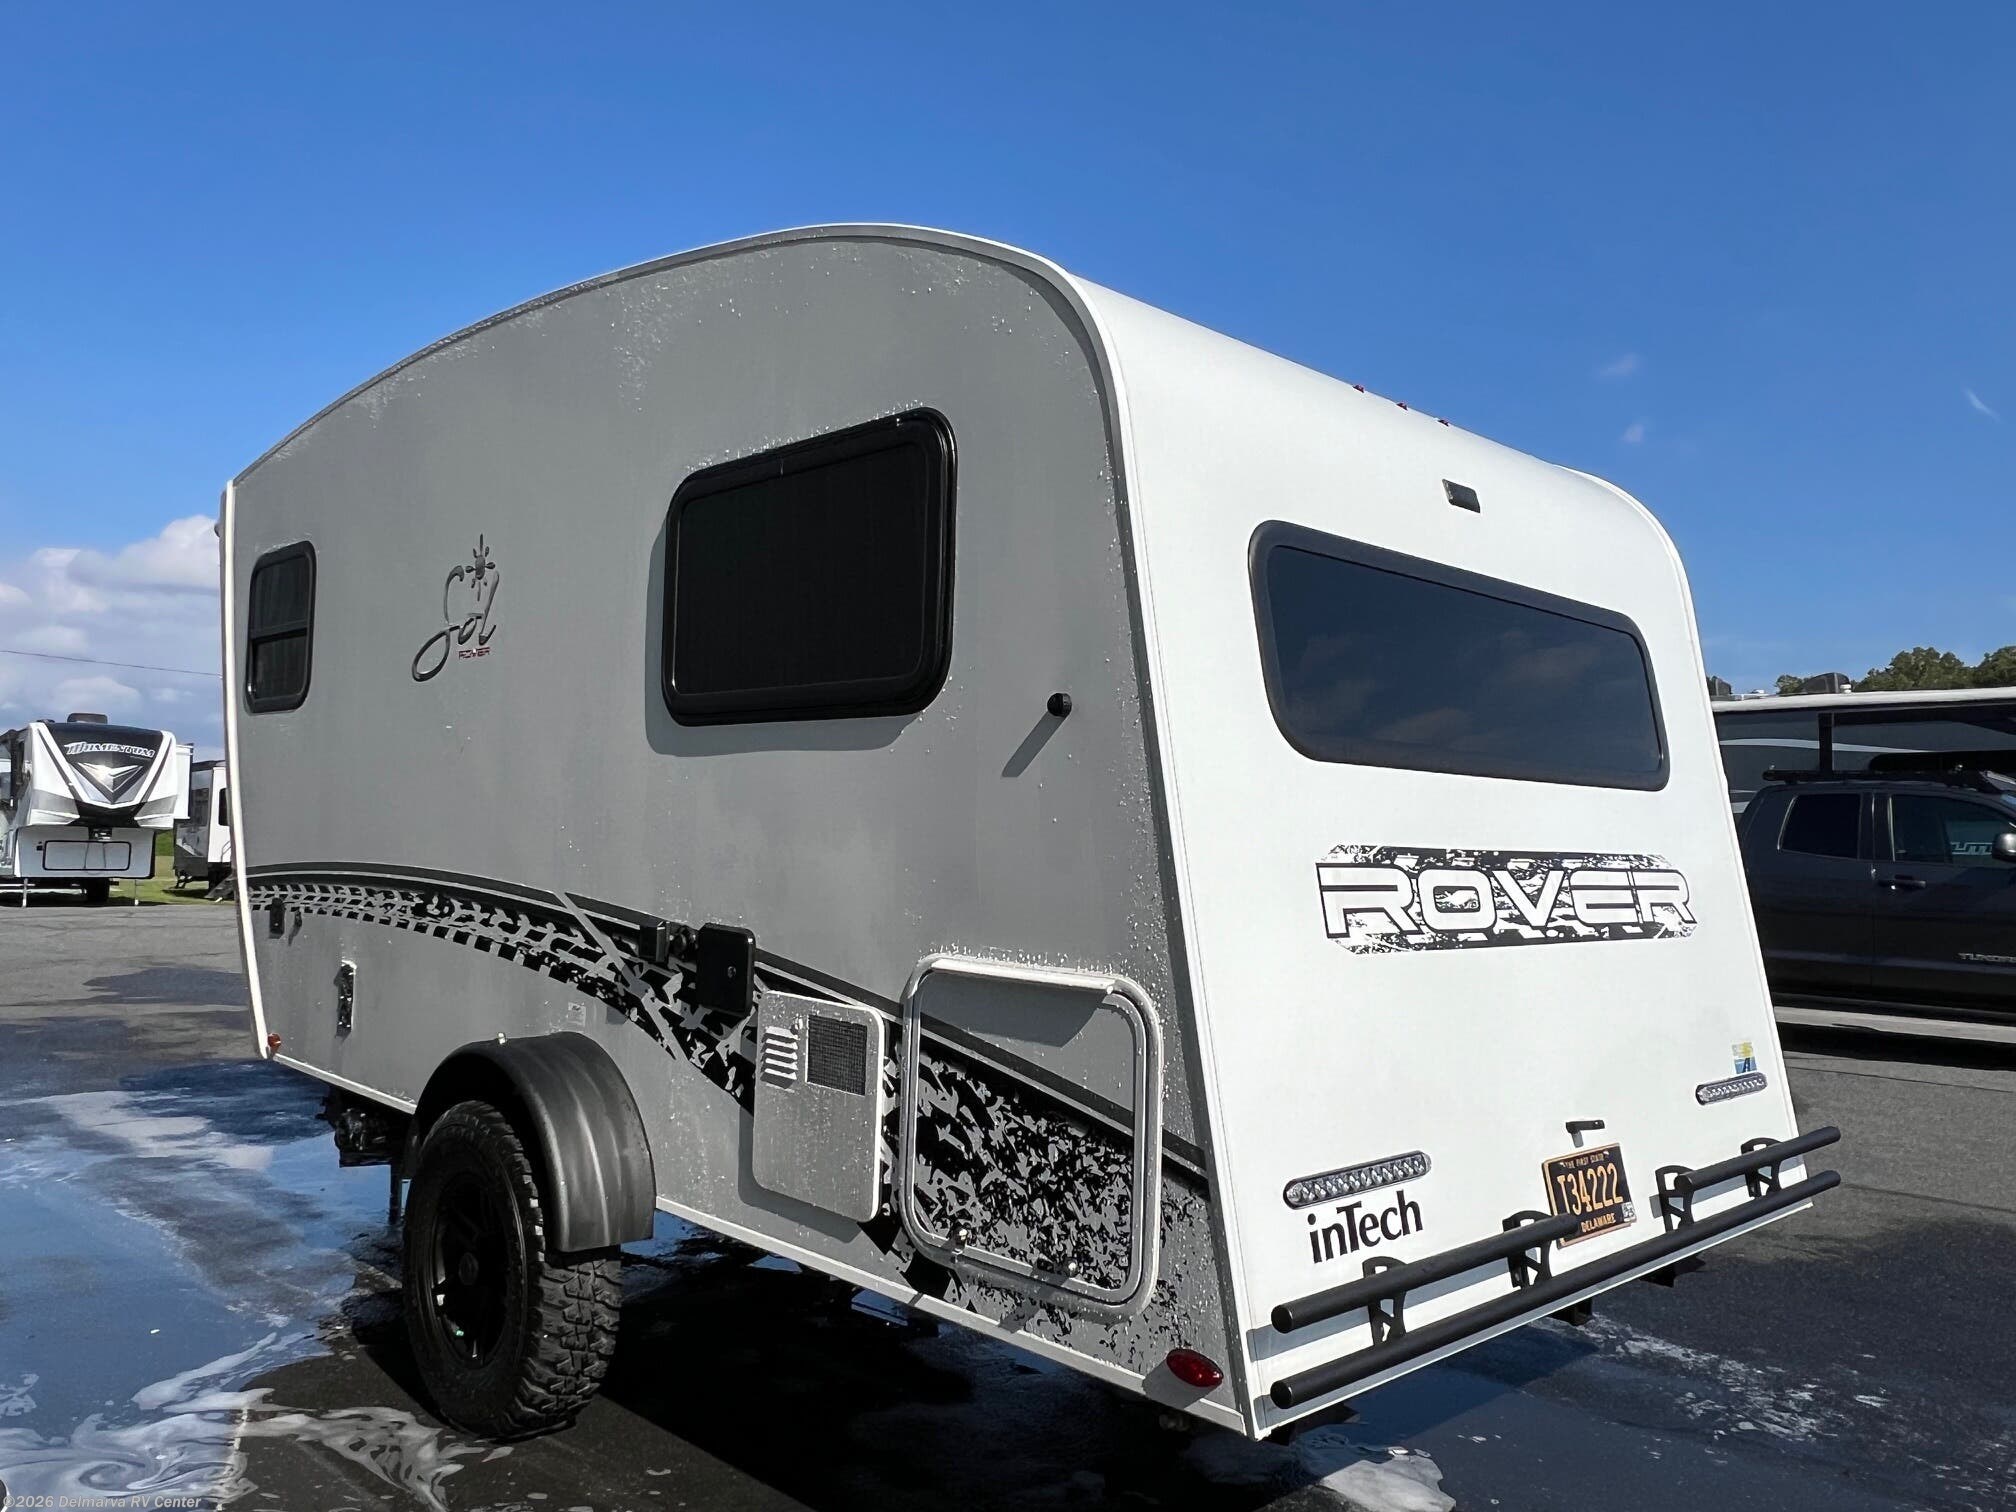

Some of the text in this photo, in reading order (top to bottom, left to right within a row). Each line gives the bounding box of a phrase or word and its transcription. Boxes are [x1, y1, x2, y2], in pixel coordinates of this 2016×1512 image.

[1316, 862, 1698, 939] ROVER
[1556, 1163, 1624, 1216] T34222
[1307, 1189, 1423, 1264] inTech
[1580, 1212, 1617, 1233] DELAWARE
